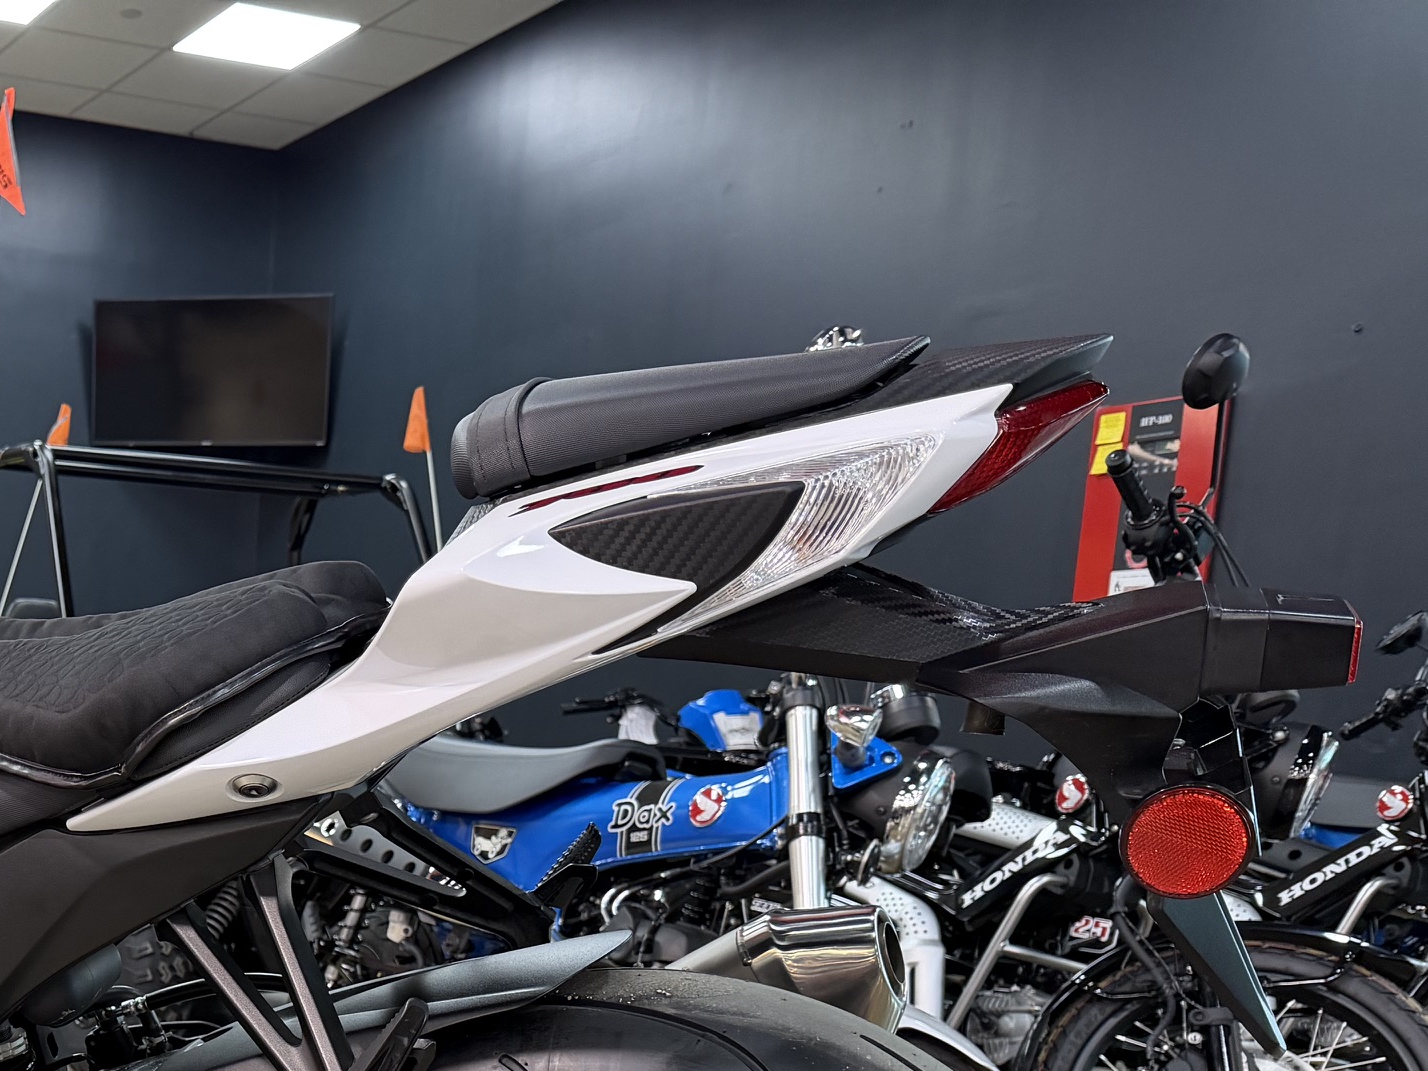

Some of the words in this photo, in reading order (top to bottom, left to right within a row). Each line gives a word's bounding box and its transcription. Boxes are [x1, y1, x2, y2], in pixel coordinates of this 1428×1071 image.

[608, 798, 676, 833] Dax
[960, 829, 1072, 909] HONDA
[1277, 832, 1400, 907] HONDA
